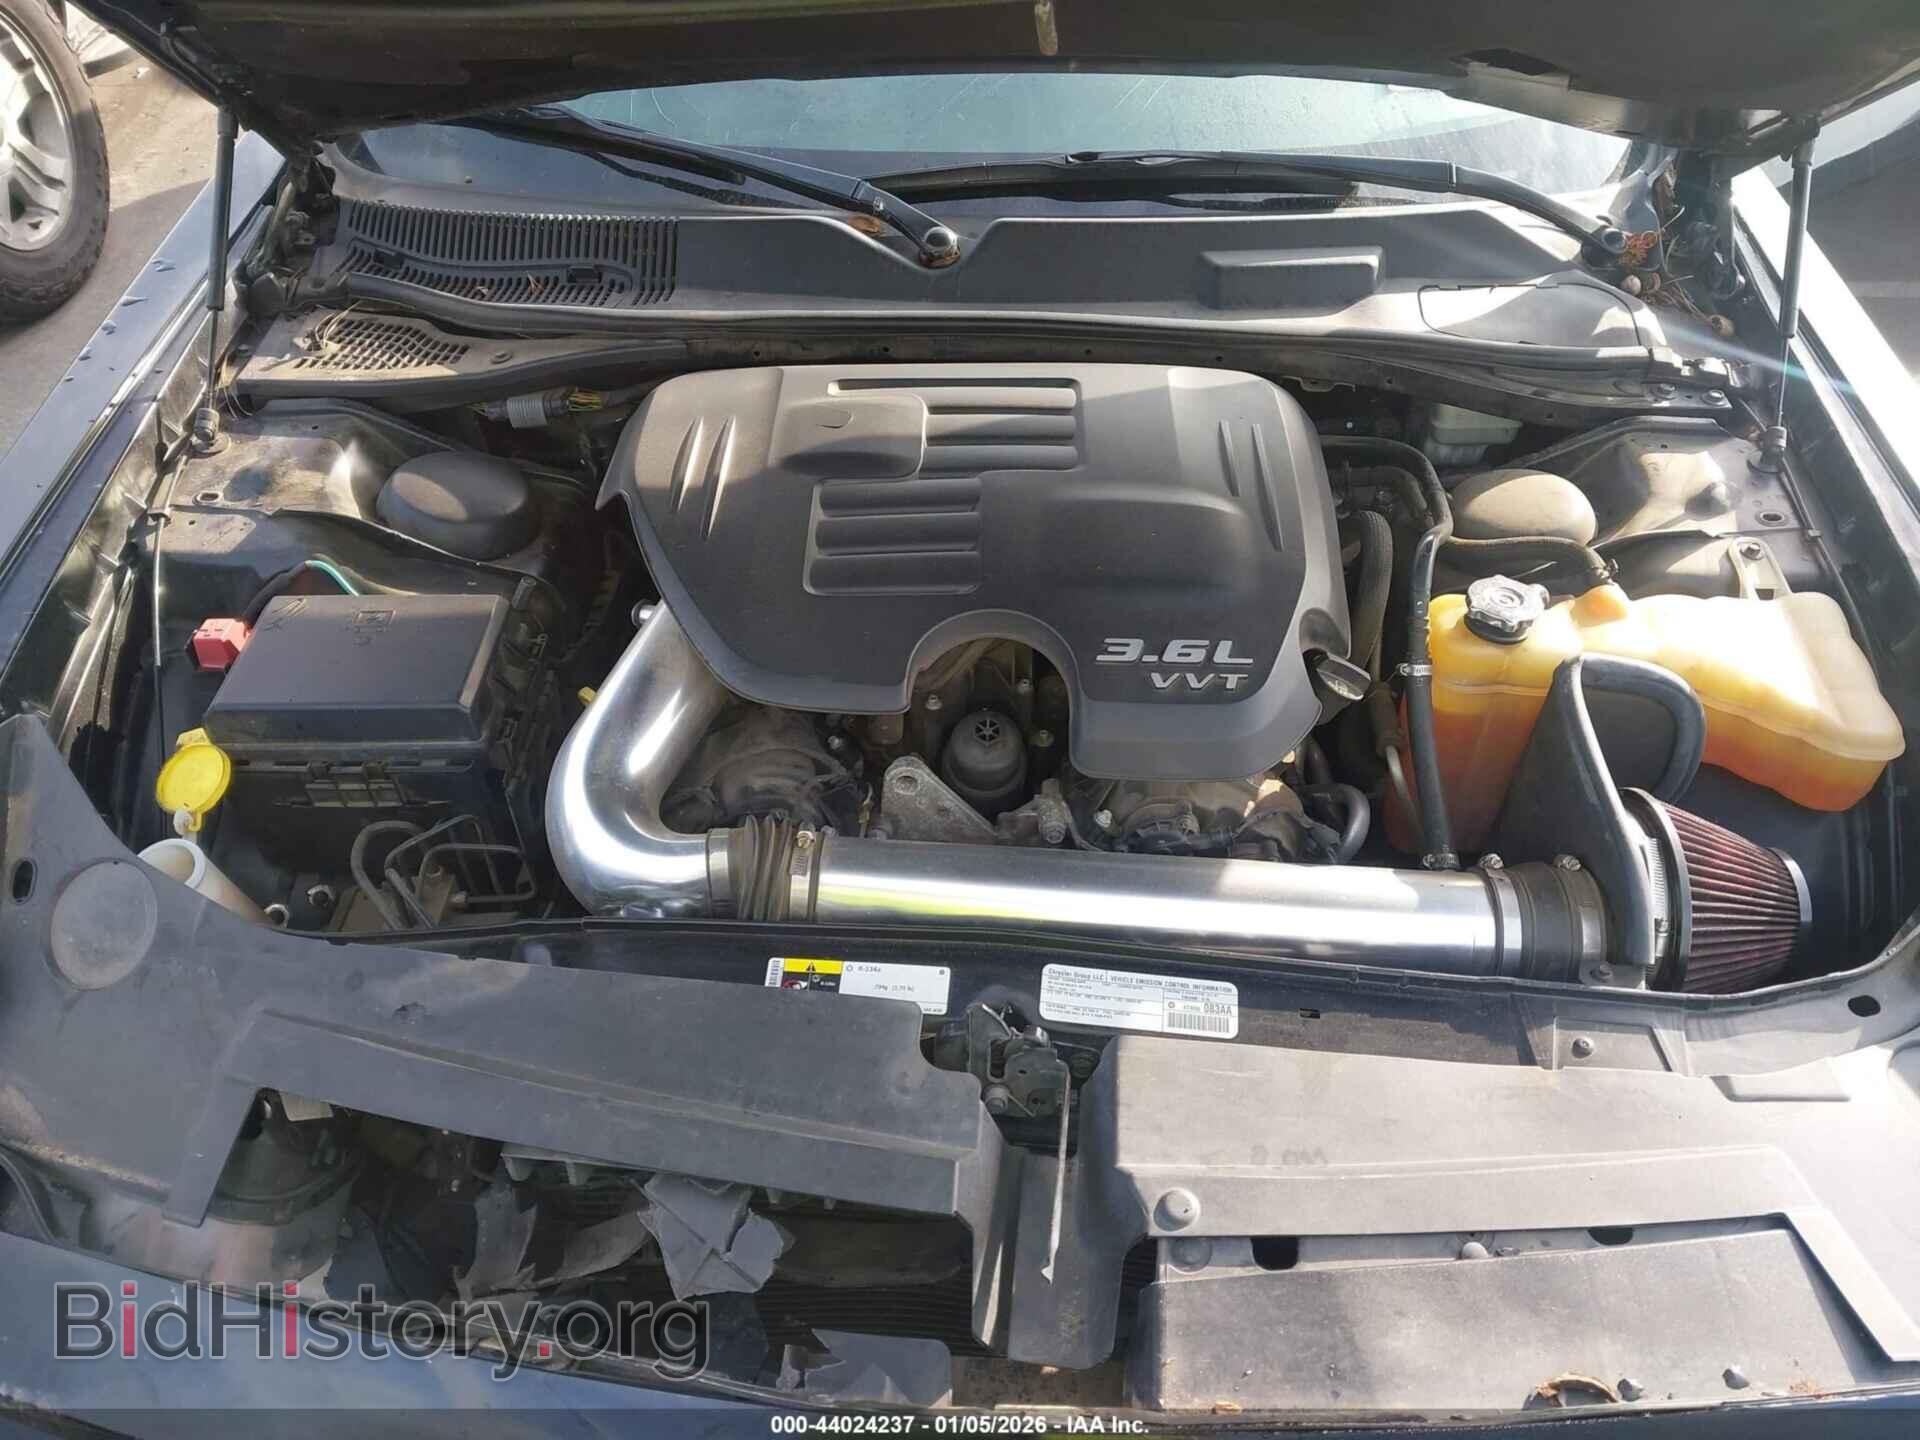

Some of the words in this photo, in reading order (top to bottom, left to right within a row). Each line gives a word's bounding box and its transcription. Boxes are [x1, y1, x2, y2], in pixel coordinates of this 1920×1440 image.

[1095, 638, 1254, 665] 3.6L
[1150, 672, 1249, 690] VVT
[1048, 967, 1073, 977] Chrysler
[1073, 971, 1091, 980] Group
[1092, 973, 1105, 981] LLC
[1110, 975, 1134, 984] VEHICLE
[1135, 976, 1163, 987] EMISSION
[1164, 981, 1190, 989] CONTROL
[1192, 983, 1233, 993] INFORMATION
